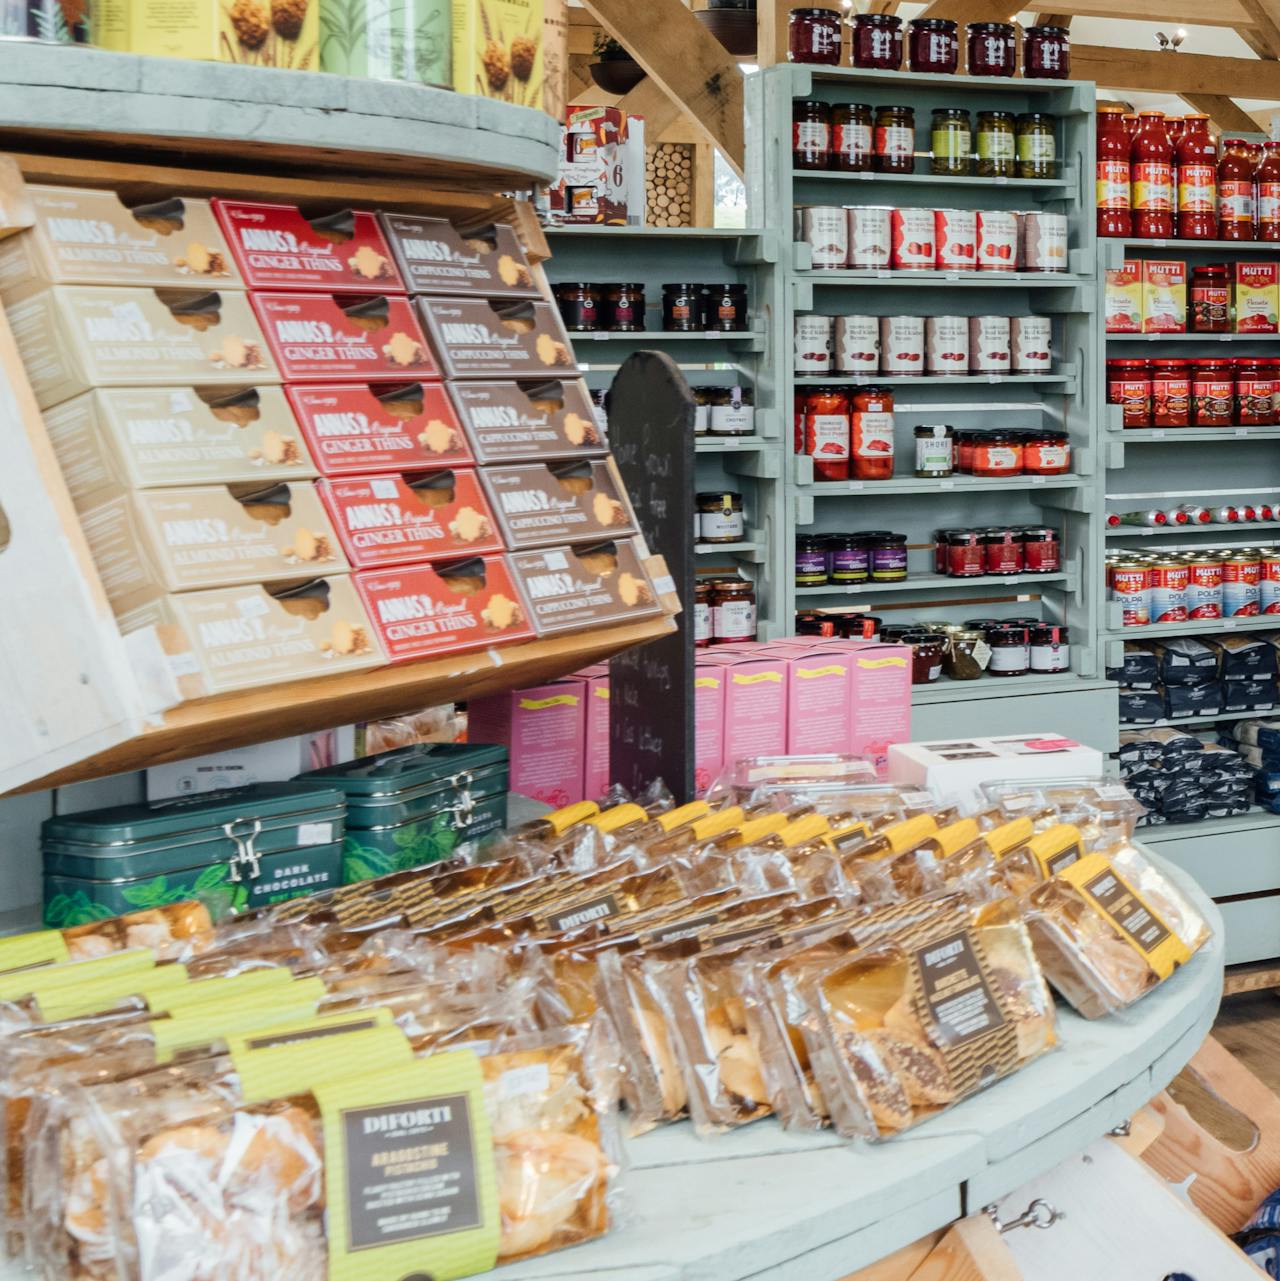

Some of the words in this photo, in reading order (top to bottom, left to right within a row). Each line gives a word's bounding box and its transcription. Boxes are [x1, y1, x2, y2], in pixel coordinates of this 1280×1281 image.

[1105, 165, 1129, 174] MUTTI
[1145, 167, 1169, 175] MUTTI
[1186, 169, 1211, 177] MUTTI
[250, 254, 303, 270] GINGER
[304, 256, 343, 271] THINS
[1149, 265, 1180, 274] MUTTI
[1242, 267, 1272, 276] MUTTI
[284, 346, 338, 361] GINGER
[341, 345, 378, 360] THINS
[321, 437, 374, 453] GINGER
[376, 435, 414, 451] THINS
[353, 530, 404, 548] GINGER
[405, 525, 445, 542] THINS
[1115, 572, 1144, 582] MUTTI
[386, 621, 438, 641] GINGER
[439, 615, 476, 632] THINS
[274, 863, 310, 879] DARK
[253, 871, 329, 896] CHOCOLATE
[559, 904, 611, 931] DIFORTI
[363, 1105, 453, 1134] DIFORTI
